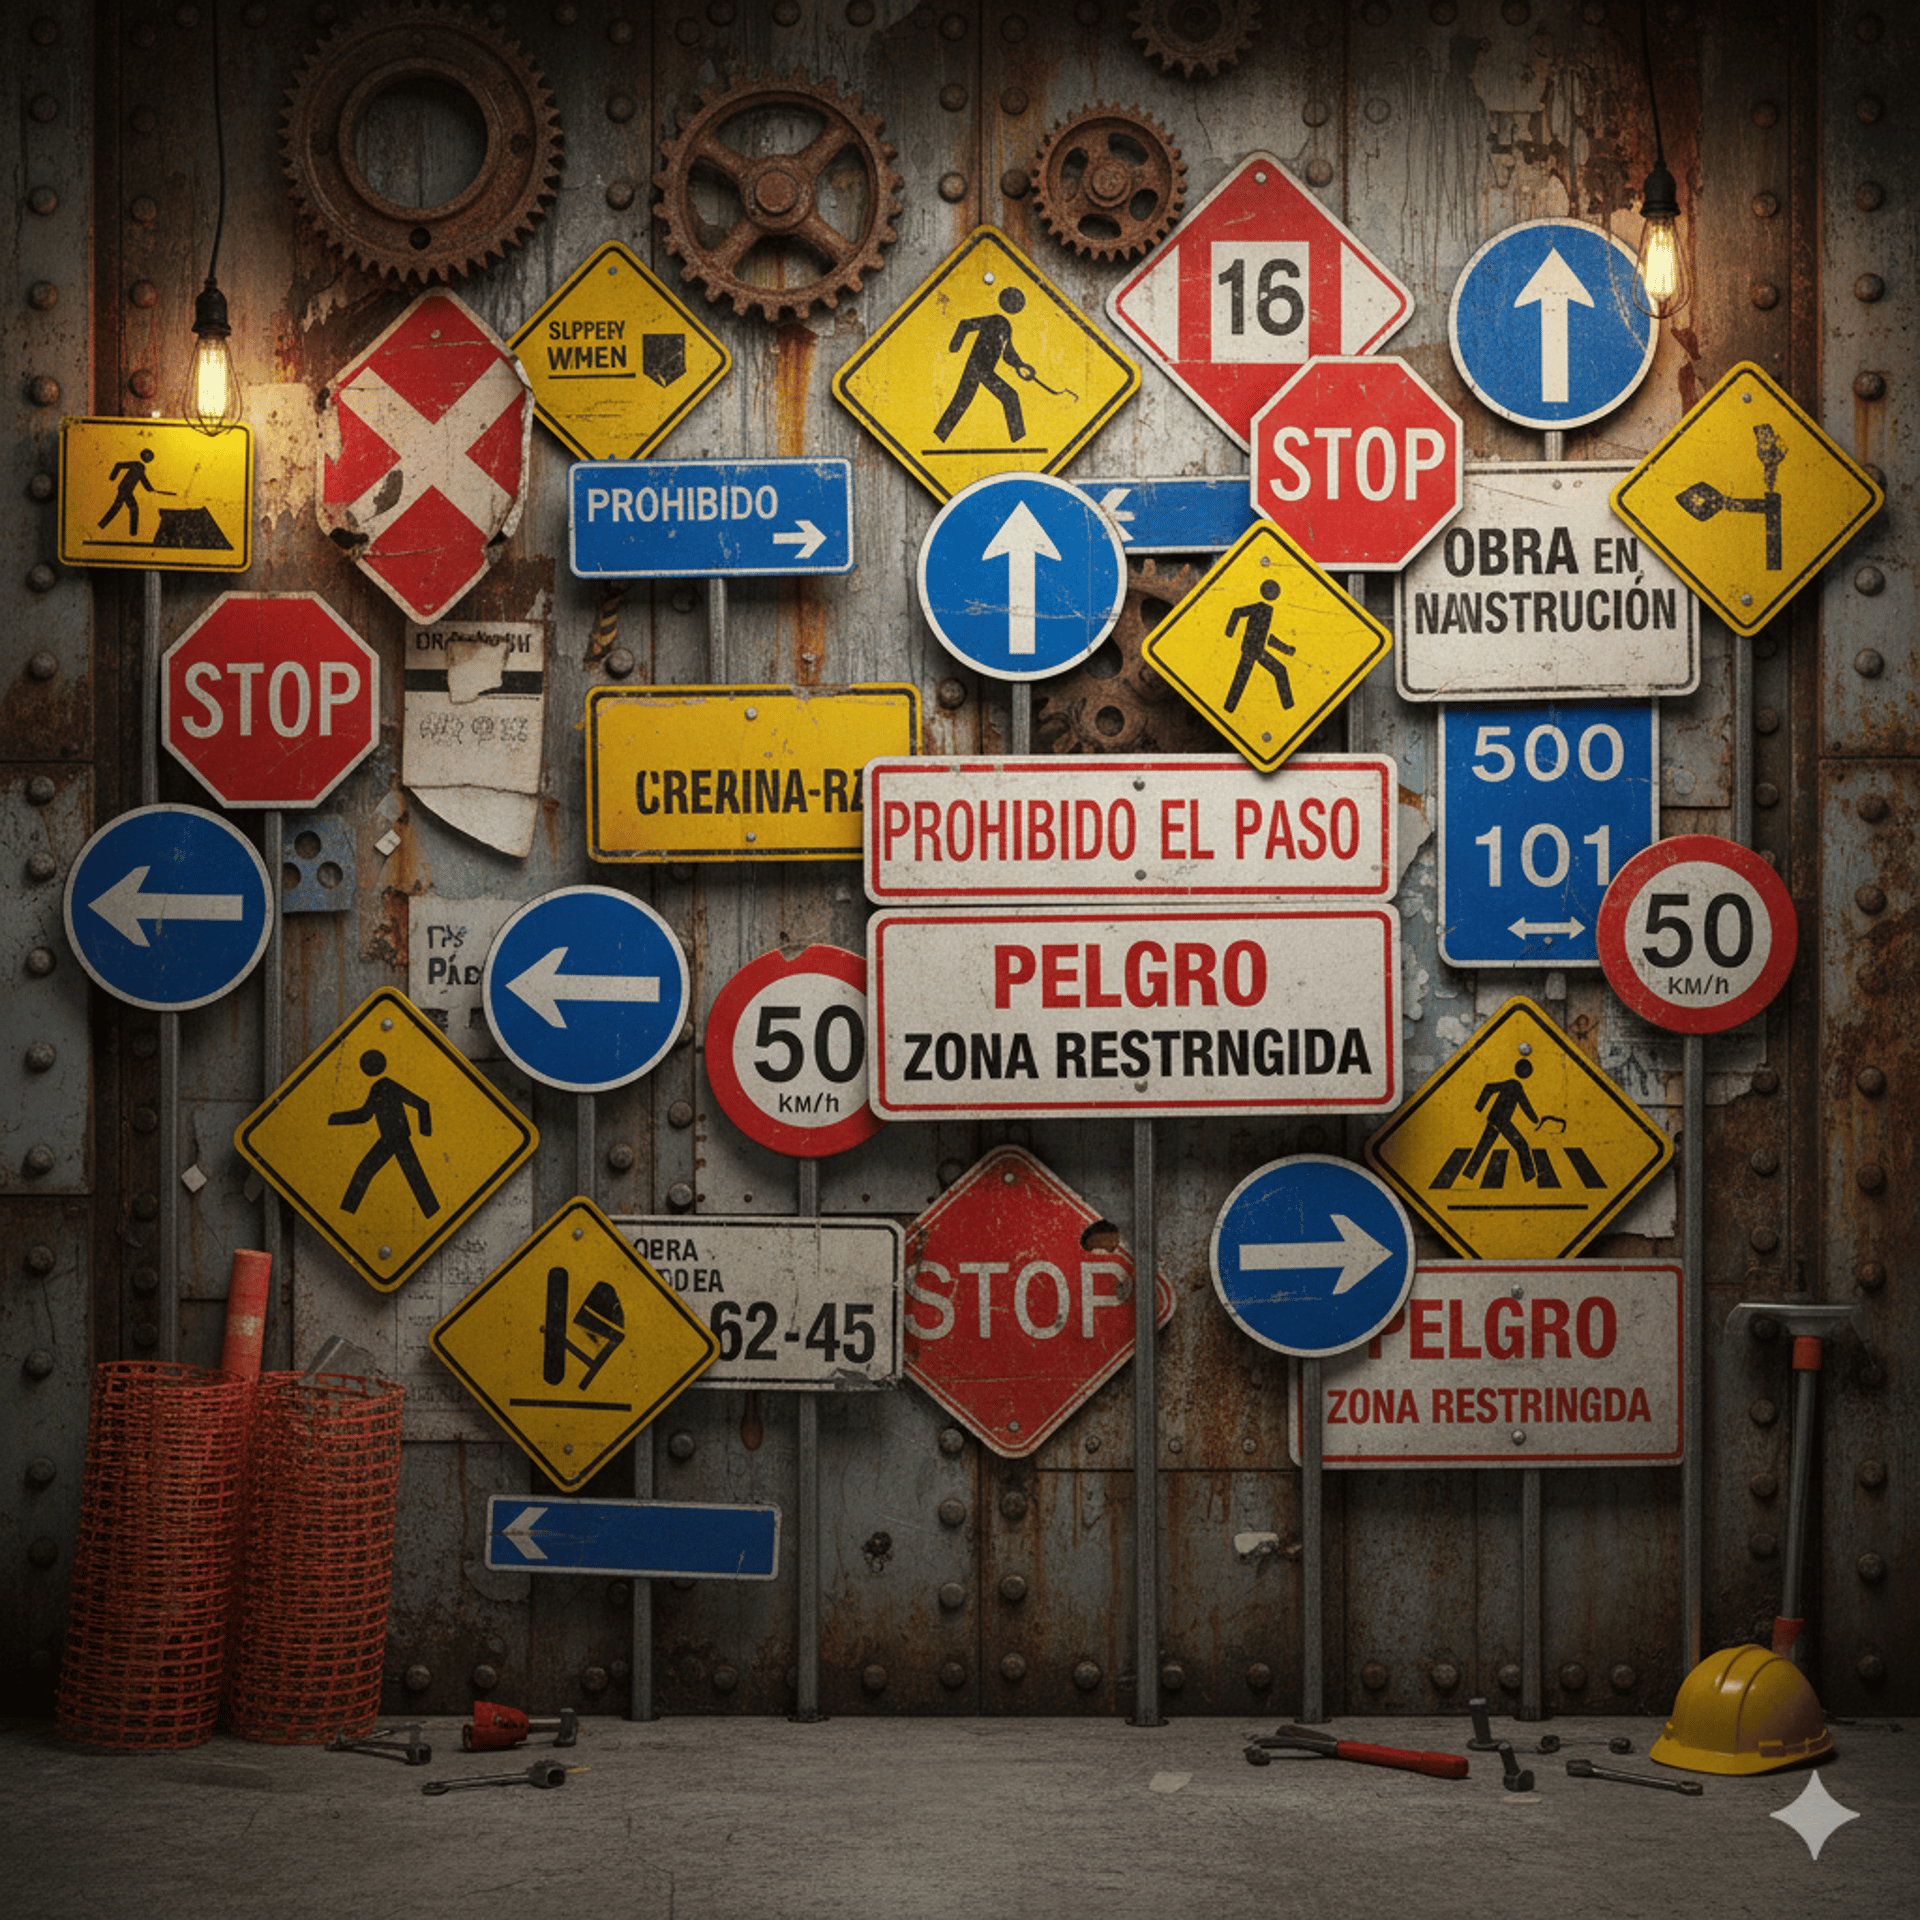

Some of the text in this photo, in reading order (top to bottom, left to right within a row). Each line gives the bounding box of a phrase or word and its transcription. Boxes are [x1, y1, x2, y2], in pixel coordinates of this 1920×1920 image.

[1218, 258, 1304, 336] 16
[1269, 426, 1446, 502] STOP
[588, 485, 779, 523] PROHIBIDO
[1443, 526, 1638, 577] OBRA EN
[181, 661, 361, 739] STOP
[1471, 723, 1625, 782] 500
[883, 797, 1360, 862] PROHIBIDO EL PASO
[1475, 823, 1610, 888] 101
[1642, 892, 1754, 968] 50
[995, 940, 1267, 1009] PELGRO
[754, 1005, 865, 1083] 50
[904, 1027, 1372, 1081] ZONA RESTRNGIDA
[710, 1301, 876, 1364] 62-45
[904, 1260, 1133, 1340] STOP
[1327, 1387, 1652, 1425] ZONA RESTRINGDA
